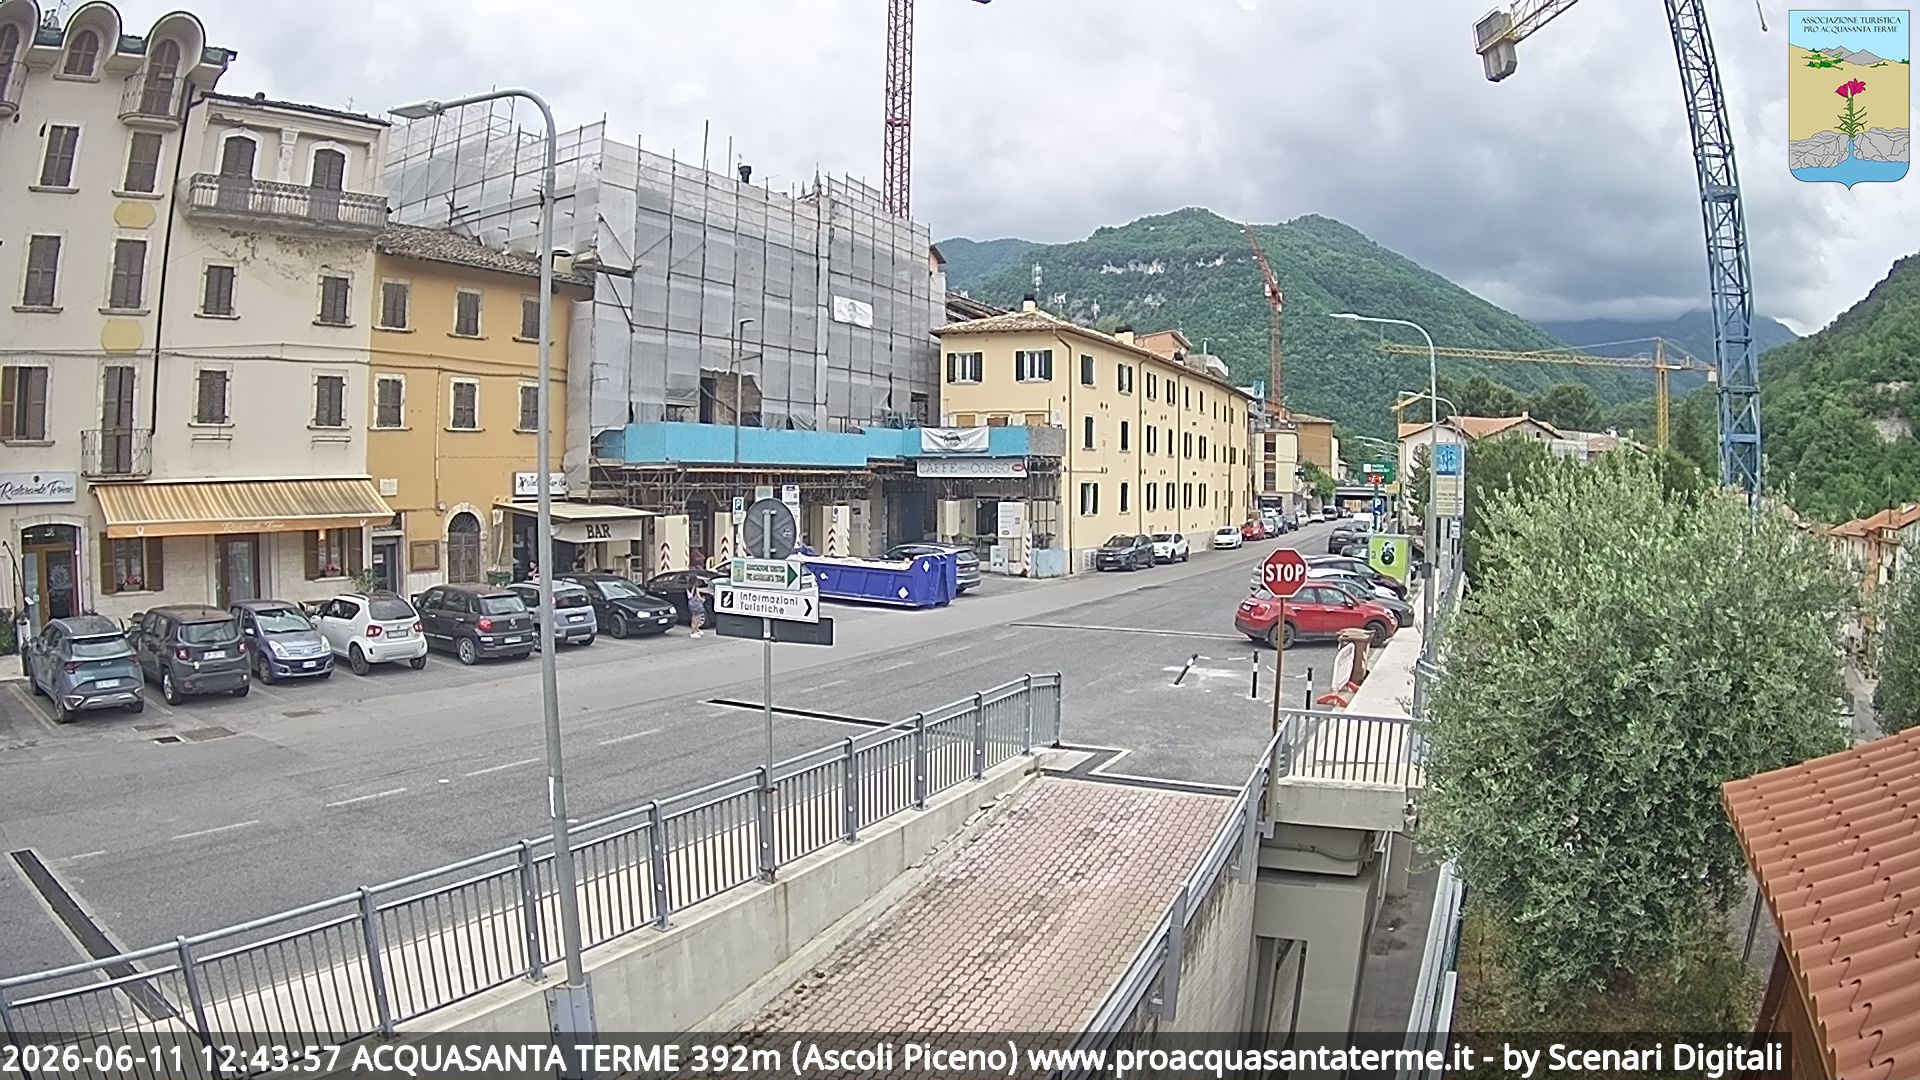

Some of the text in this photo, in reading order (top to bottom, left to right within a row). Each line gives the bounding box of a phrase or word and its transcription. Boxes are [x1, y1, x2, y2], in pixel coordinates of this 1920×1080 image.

[970, 463, 1010, 473] CORSO
[585, 523, 611, 539] BAR
[1265, 563, 1304, 582] STOP
[740, 591, 798, 606] Informazioni
[740, 601, 785, 615] Turistiche
